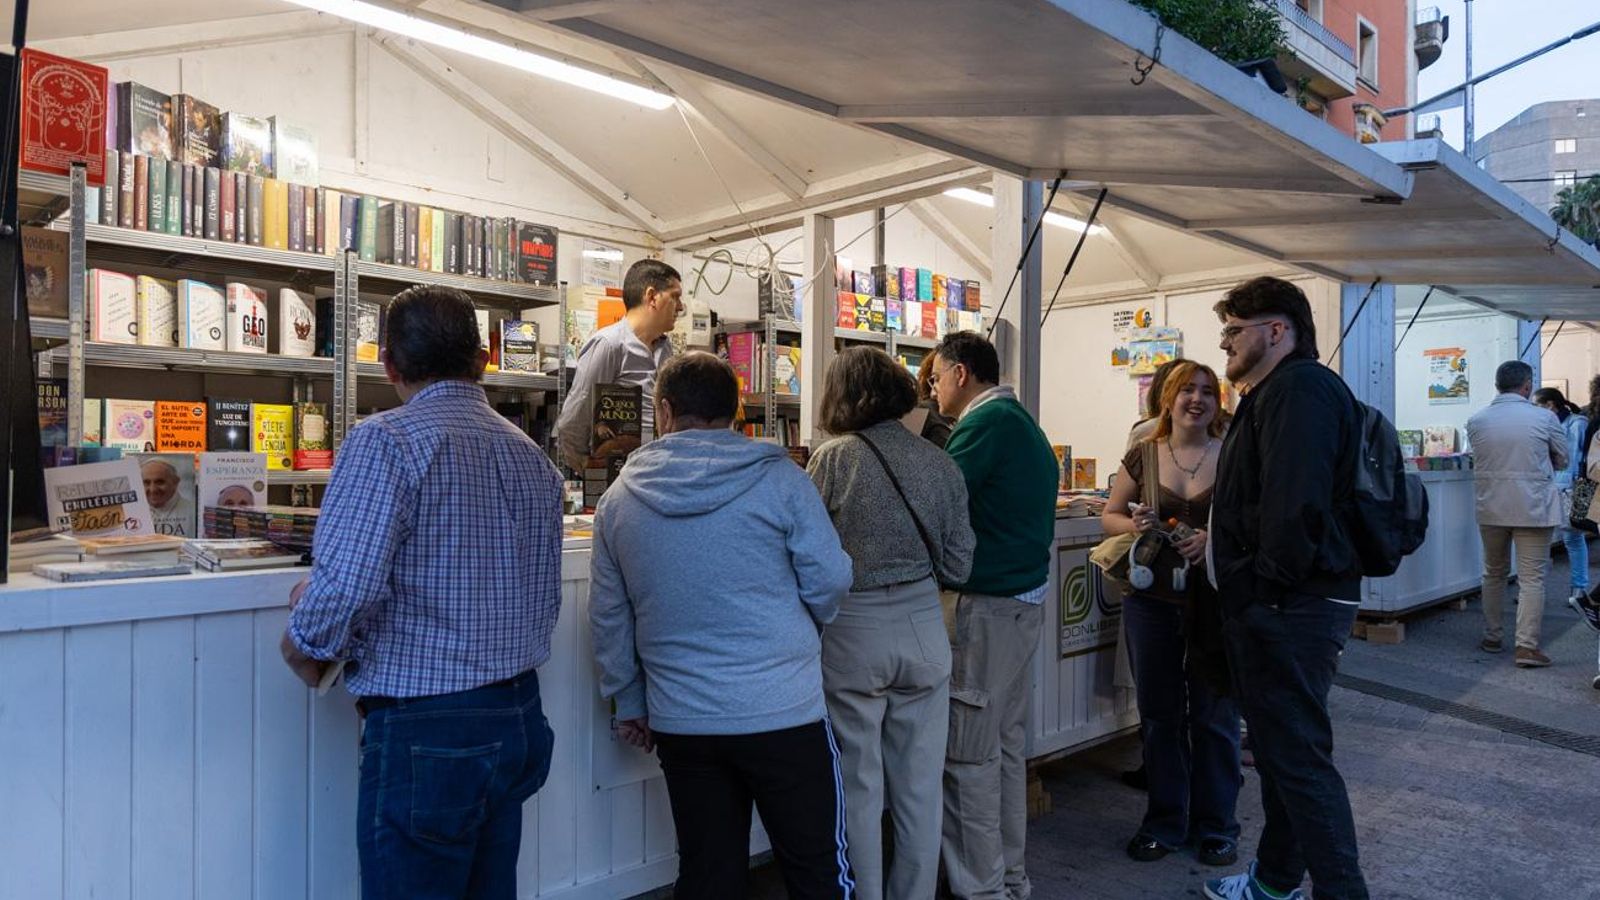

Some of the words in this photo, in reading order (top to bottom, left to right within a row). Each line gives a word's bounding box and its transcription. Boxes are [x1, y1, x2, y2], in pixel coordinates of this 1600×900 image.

[243, 315, 265, 336] GEO
[600, 410, 637, 420] MUNDO
[161, 440, 203, 448] MIRDA
[206, 466, 264, 475] ESPERANZA
[152, 523, 185, 536] IDA
